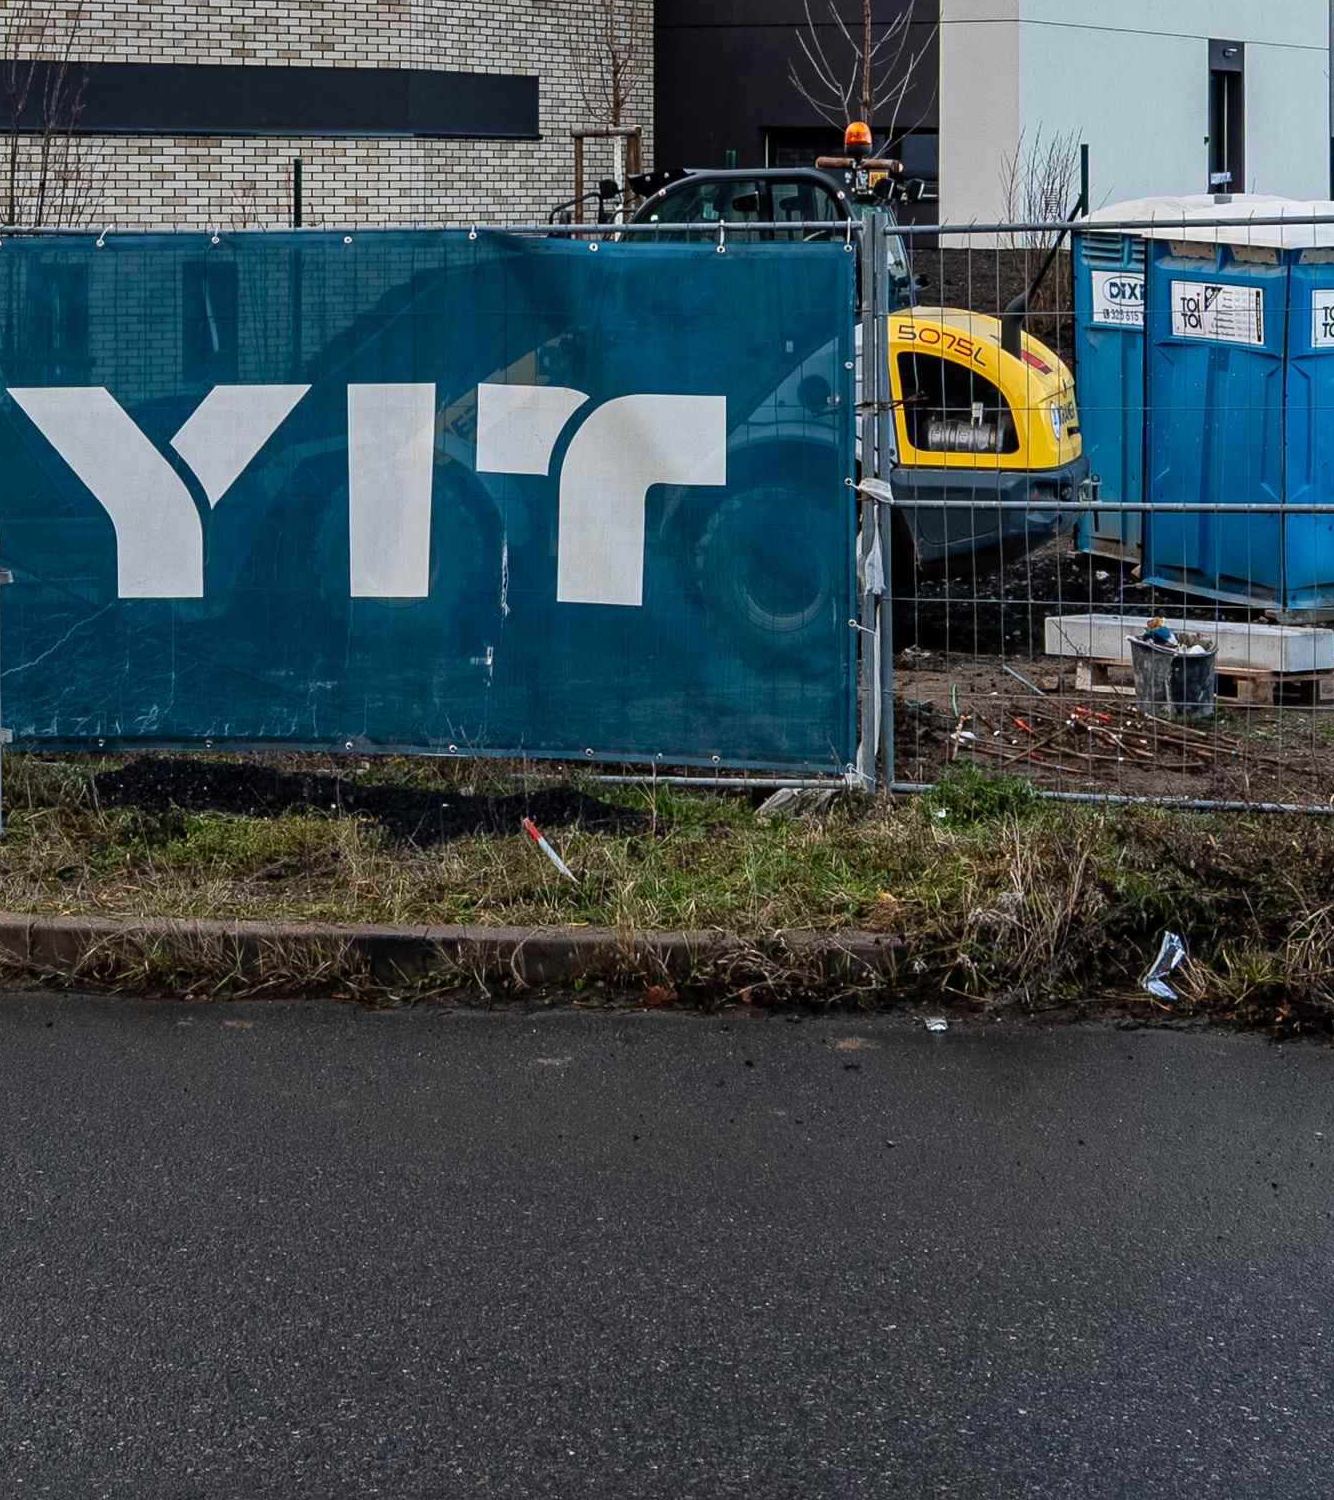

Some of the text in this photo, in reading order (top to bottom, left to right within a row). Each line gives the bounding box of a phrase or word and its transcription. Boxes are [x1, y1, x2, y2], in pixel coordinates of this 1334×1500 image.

[1180, 312, 1202, 330] TOI
[898, 324, 986, 366] 5075L
[7, 382, 727, 606] YIT
